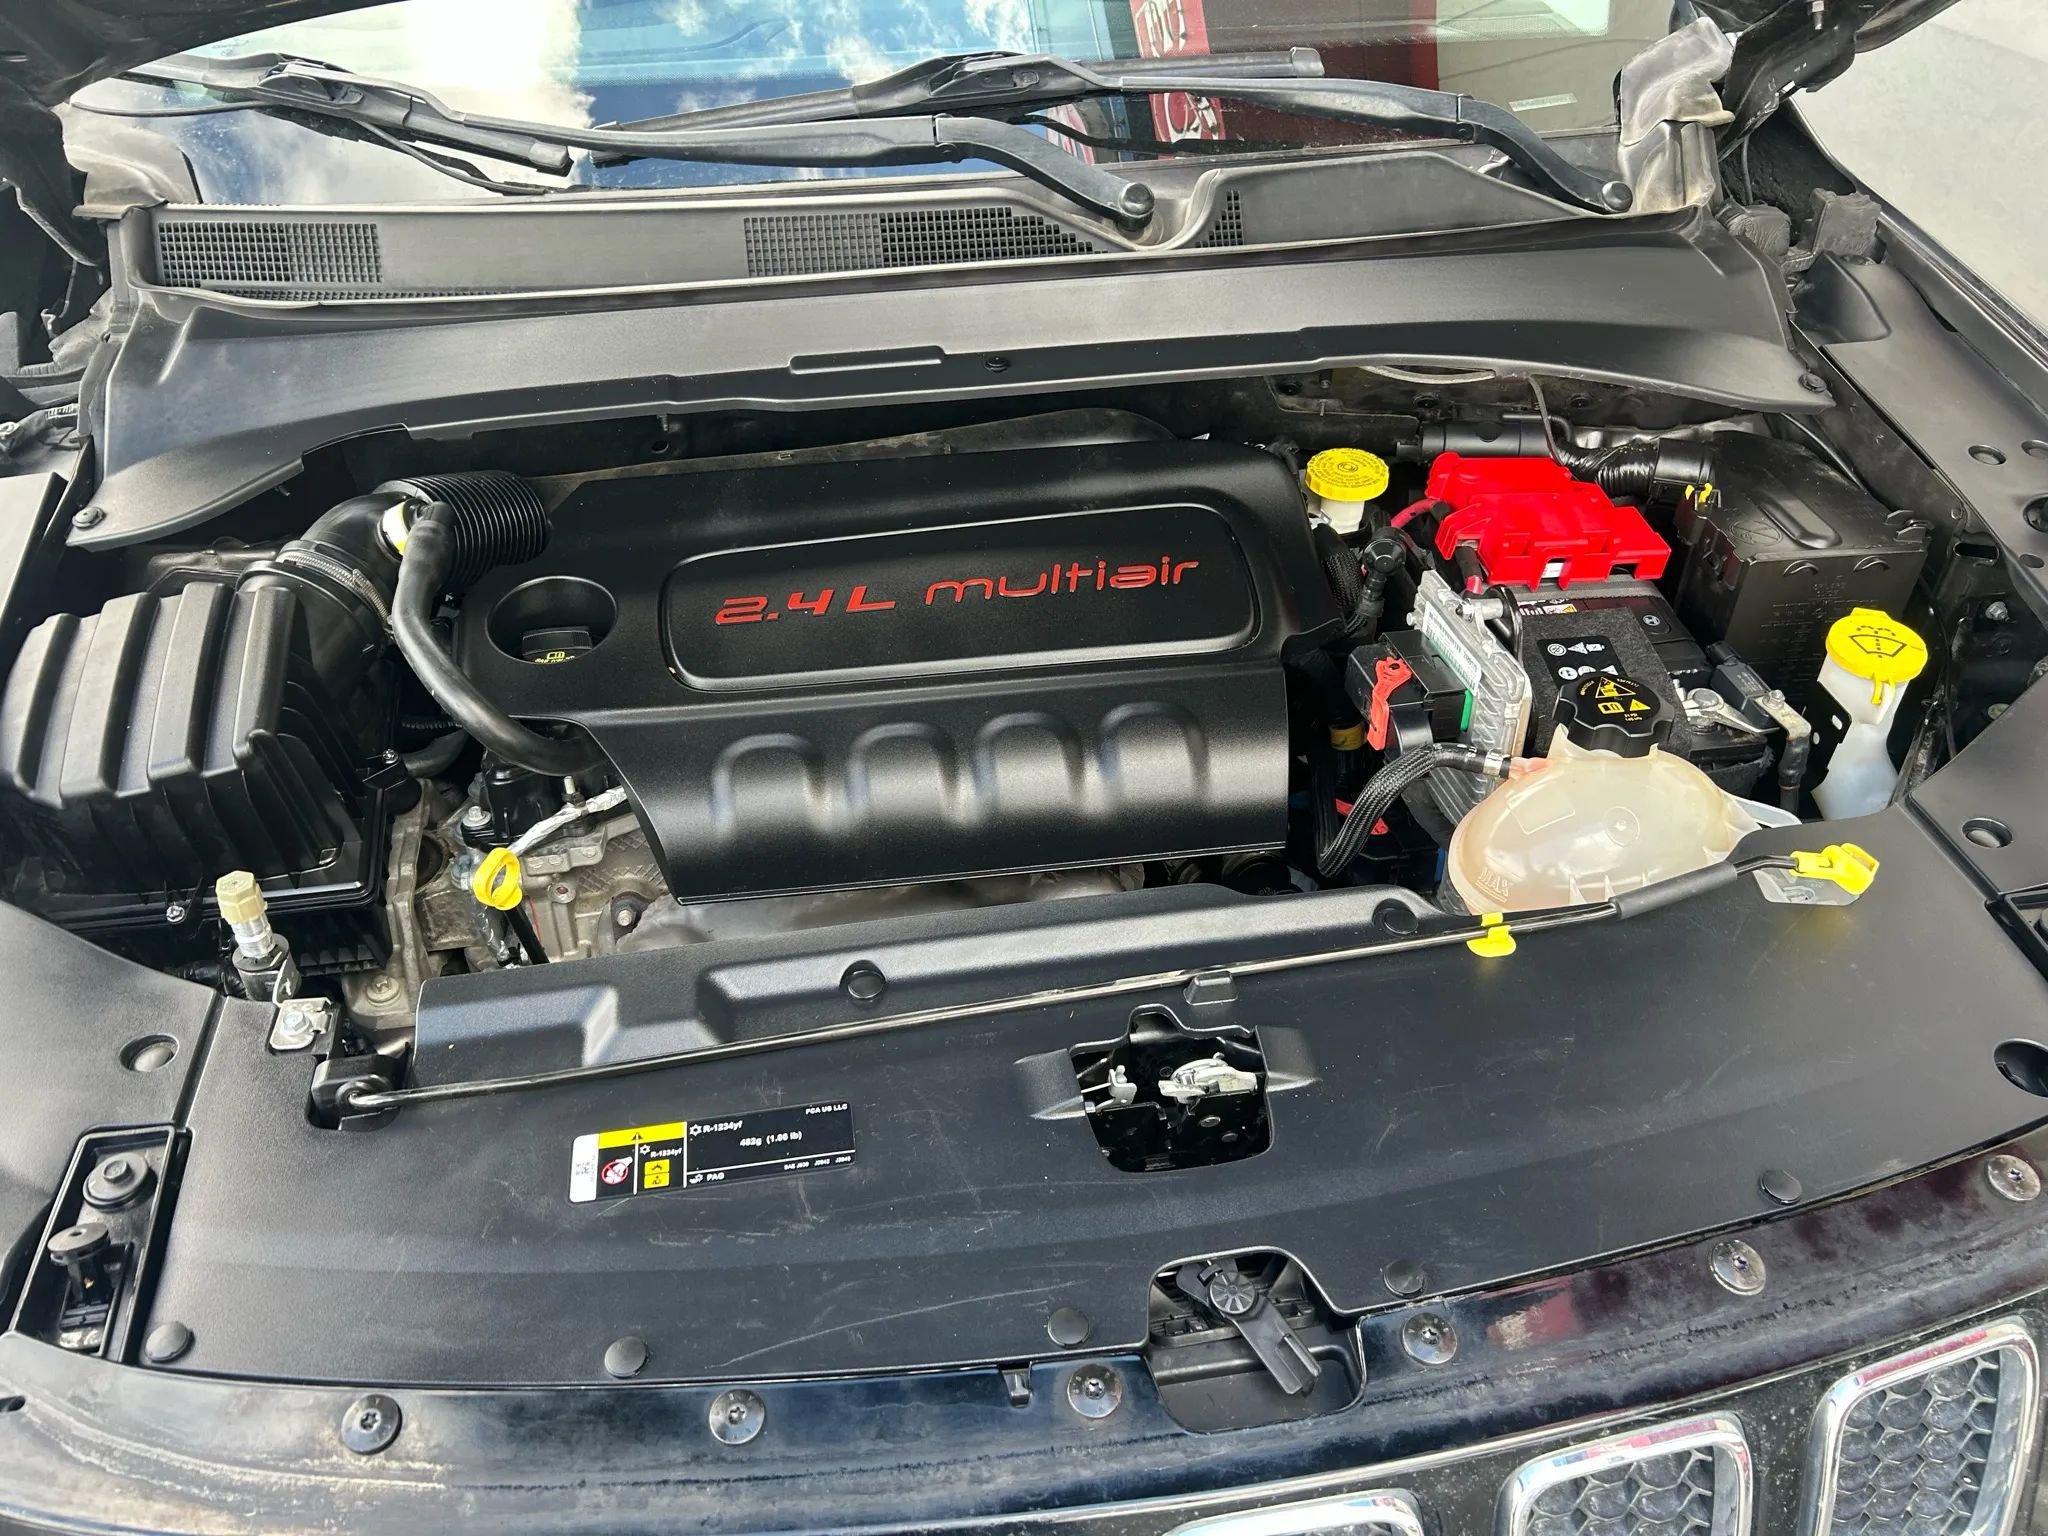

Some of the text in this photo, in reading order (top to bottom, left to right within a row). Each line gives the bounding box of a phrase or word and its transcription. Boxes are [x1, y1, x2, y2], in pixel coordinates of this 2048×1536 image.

[925, 555, 1200, 606] multiair
[1477, 866, 1510, 897] MAX
[805, 1107, 821, 1115] FCA
[833, 1103, 848, 1111] LLC
[702, 1120, 743, 1133] R-1234yf
[789, 1130, 803, 1141] lb)
[650, 1147, 682, 1158] R-1234yf
